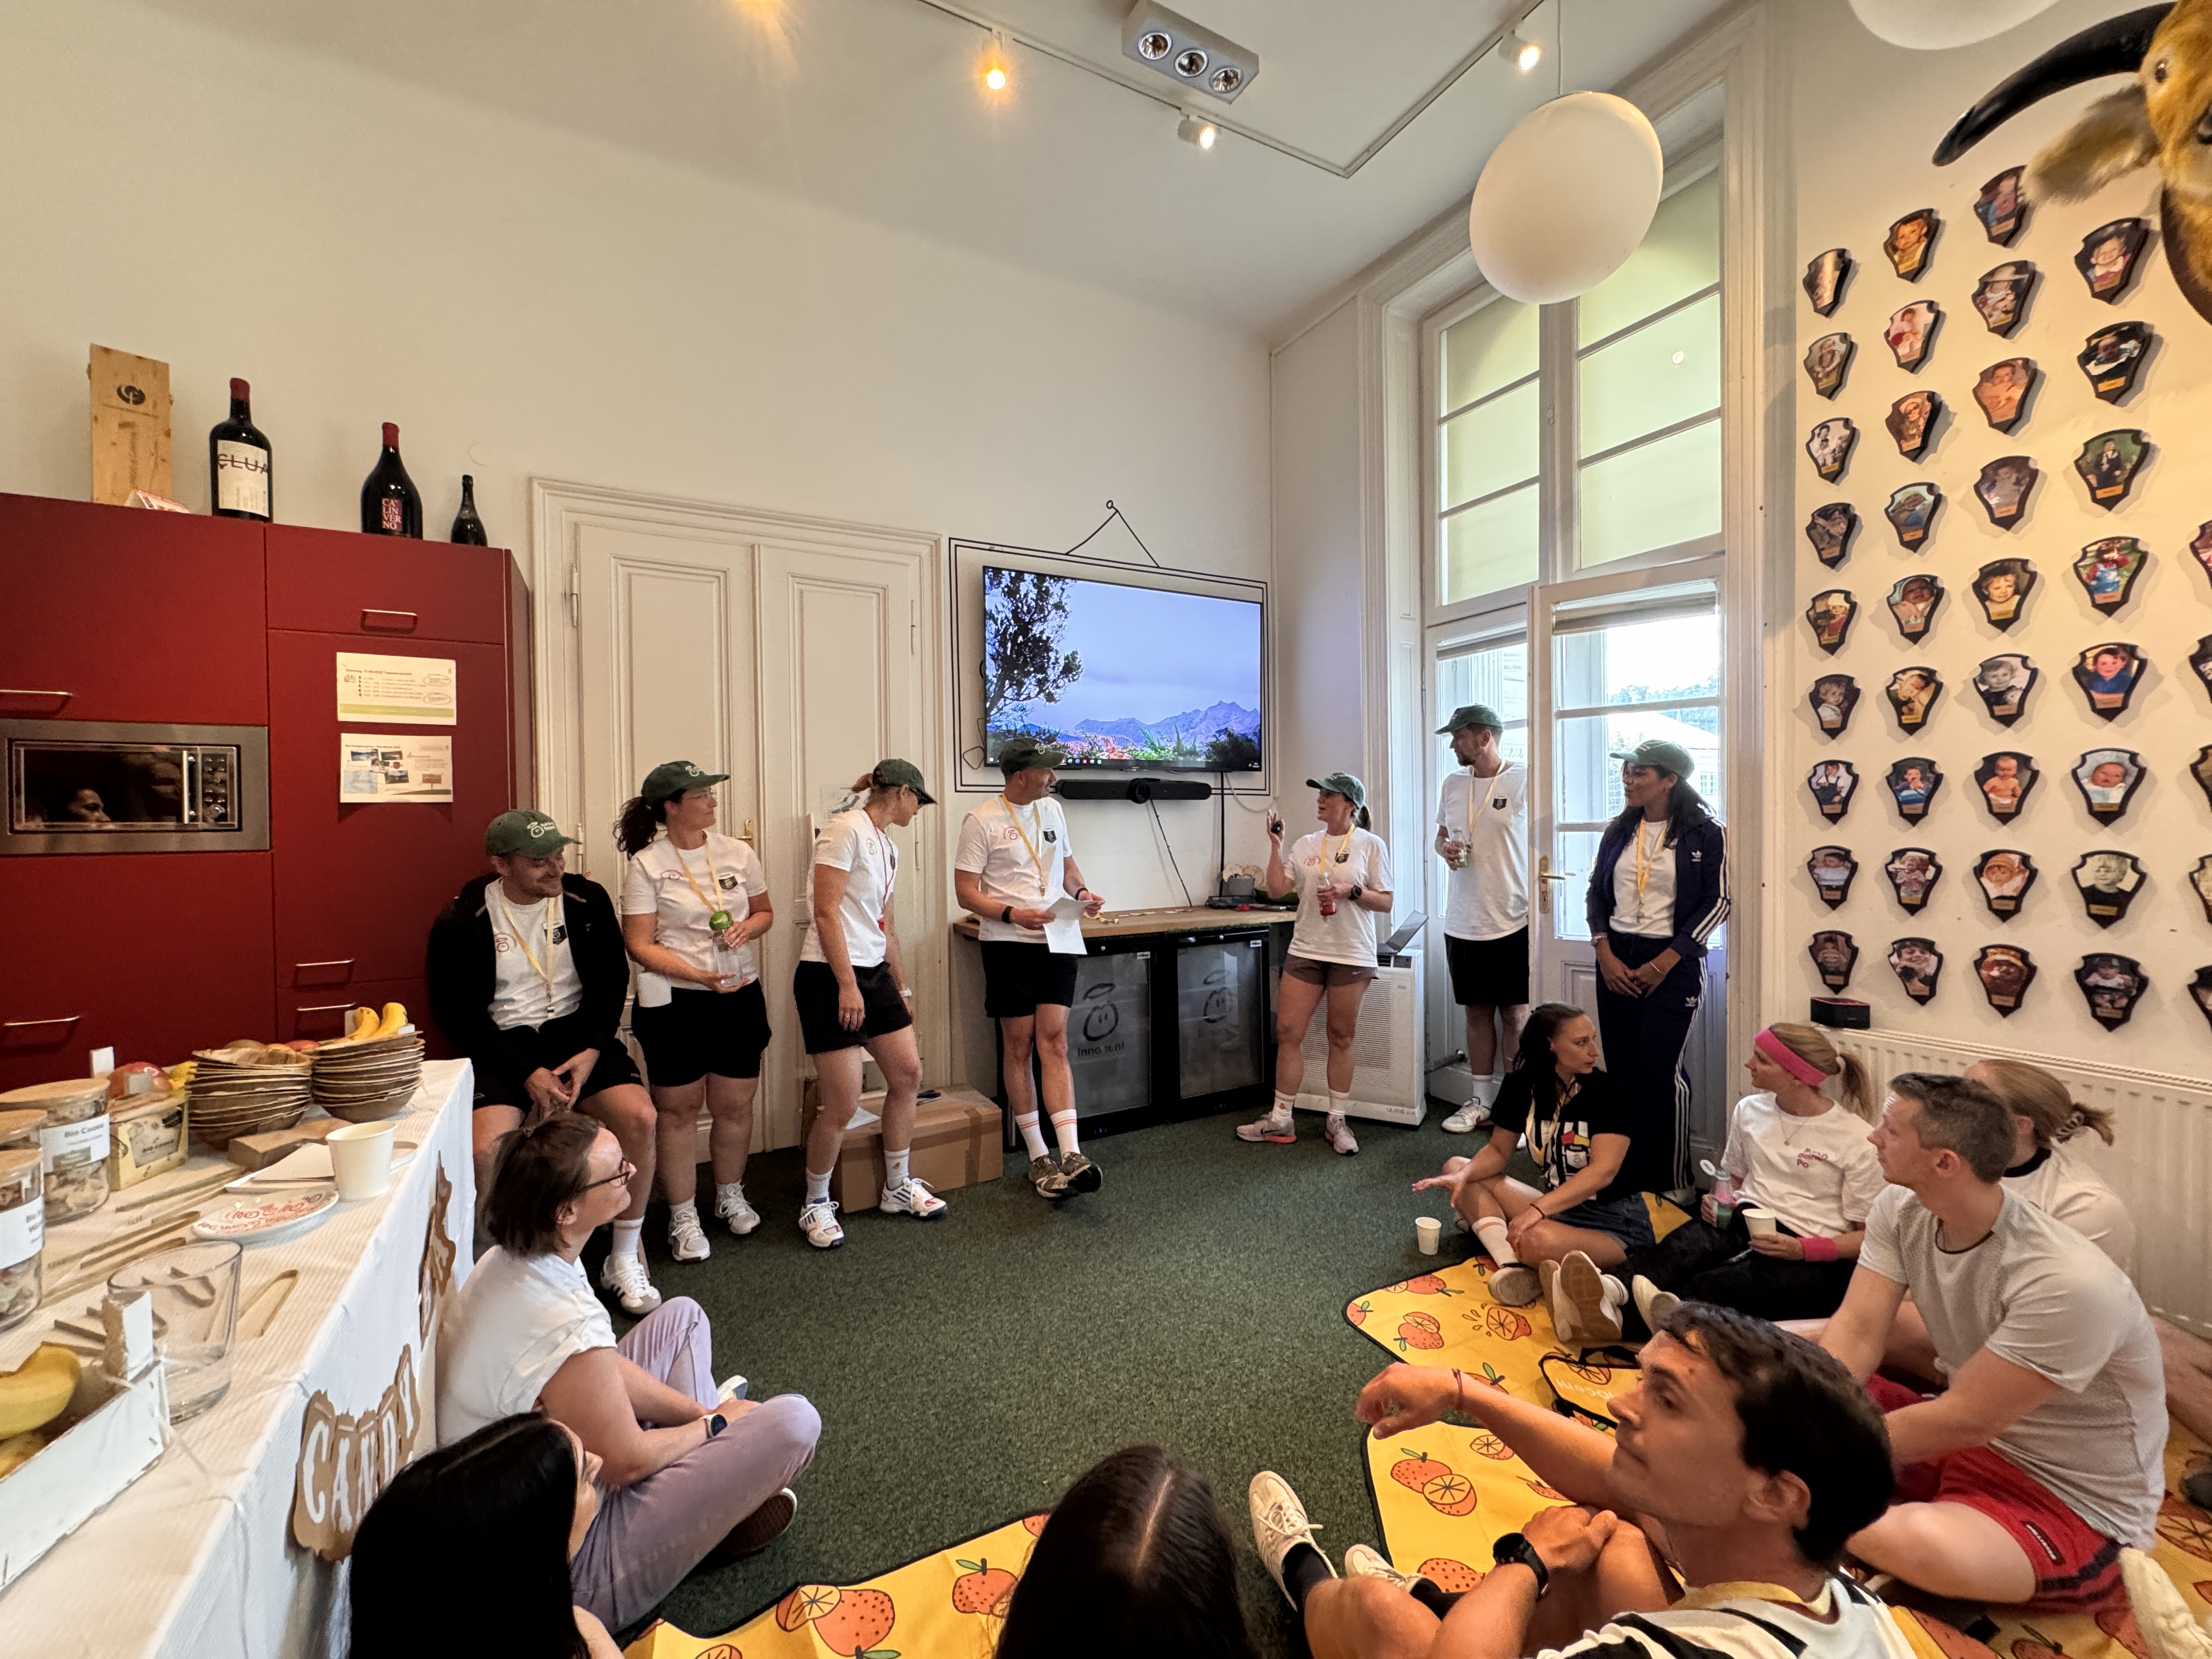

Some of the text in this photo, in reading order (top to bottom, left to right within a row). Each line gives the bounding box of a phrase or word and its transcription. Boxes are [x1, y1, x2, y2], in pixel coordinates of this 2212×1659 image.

[382, 505, 398, 515] LIN
[383, 513, 402, 523] VER
[382, 521, 397, 530] NO
